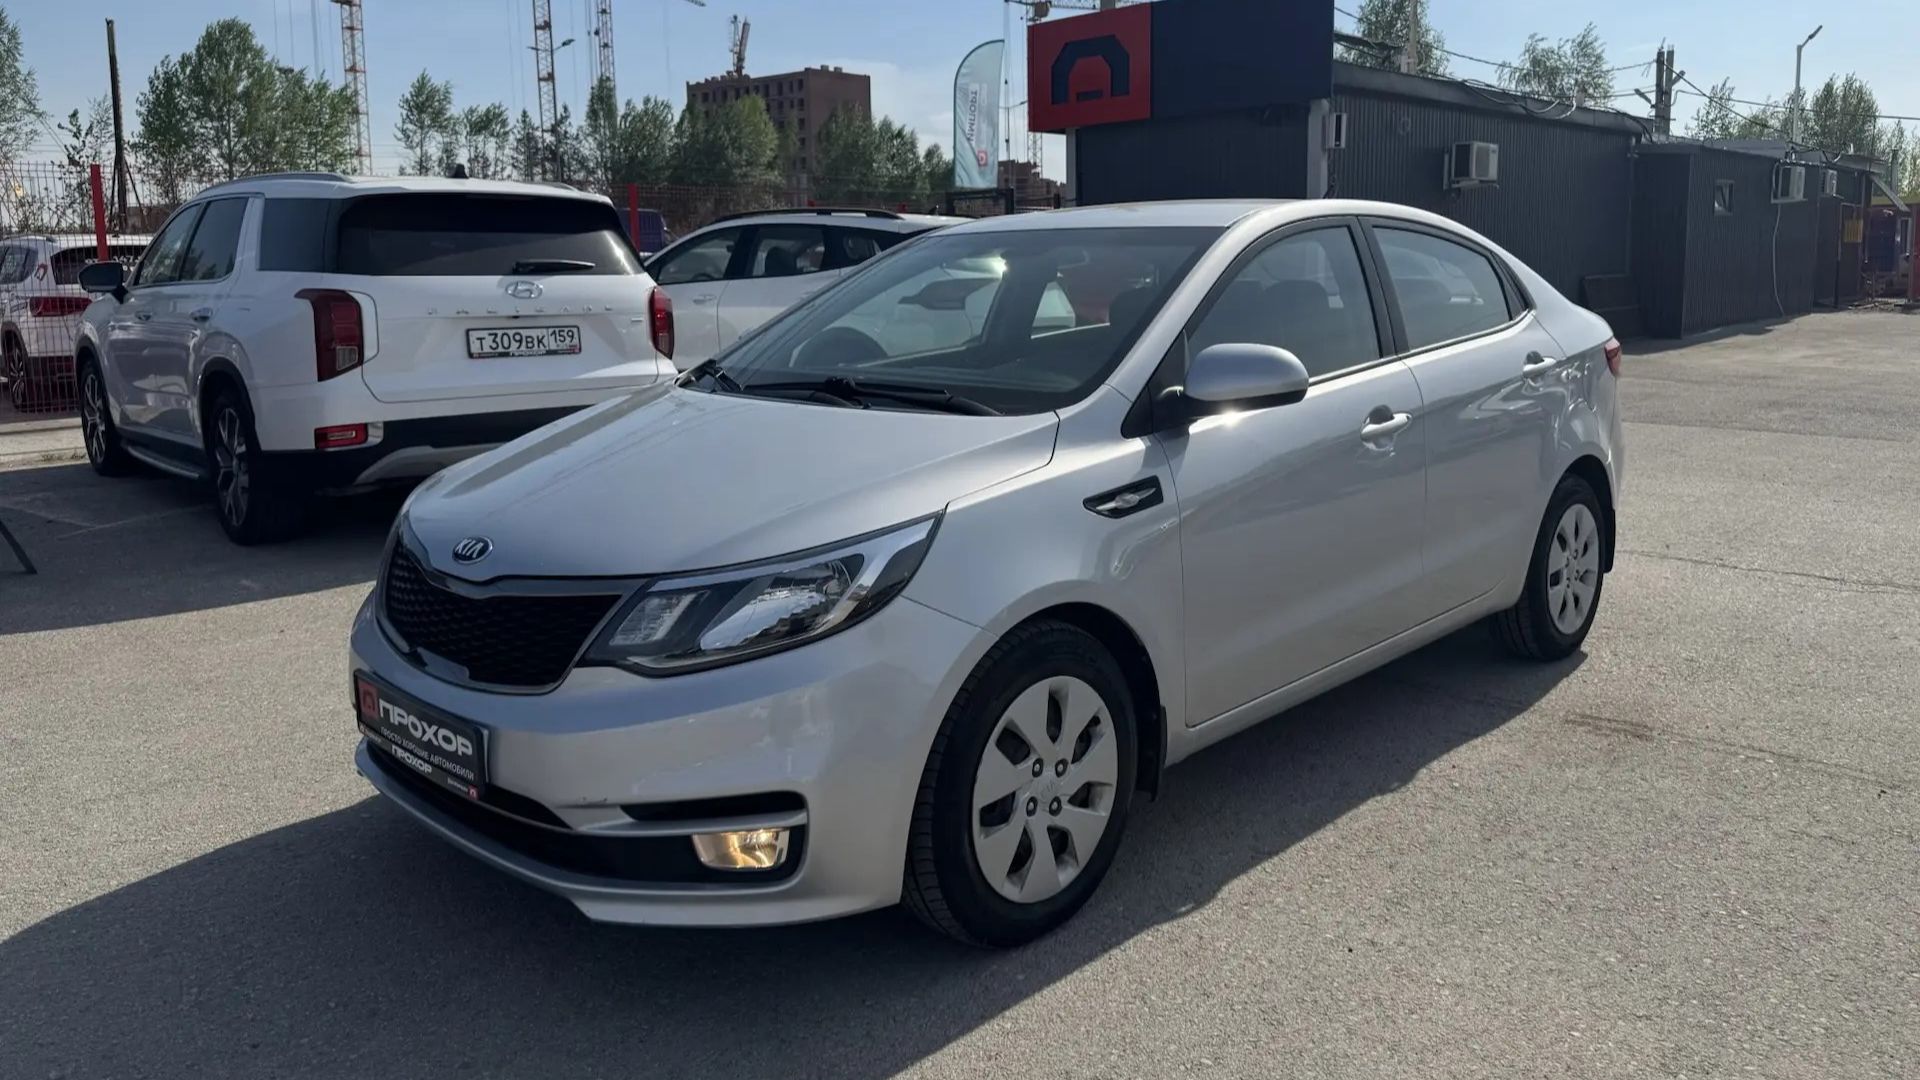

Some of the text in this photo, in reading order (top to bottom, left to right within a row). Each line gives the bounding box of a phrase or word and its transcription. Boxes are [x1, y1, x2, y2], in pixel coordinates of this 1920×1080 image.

[475, 328, 575, 351] Т309ВК 159
[455, 538, 484, 558] KIA
[379, 698, 473, 756] ПРОХОР
[391, 743, 433, 774] ПРОХОР
[430, 753, 475, 781] АВТОМОБИЛИ
